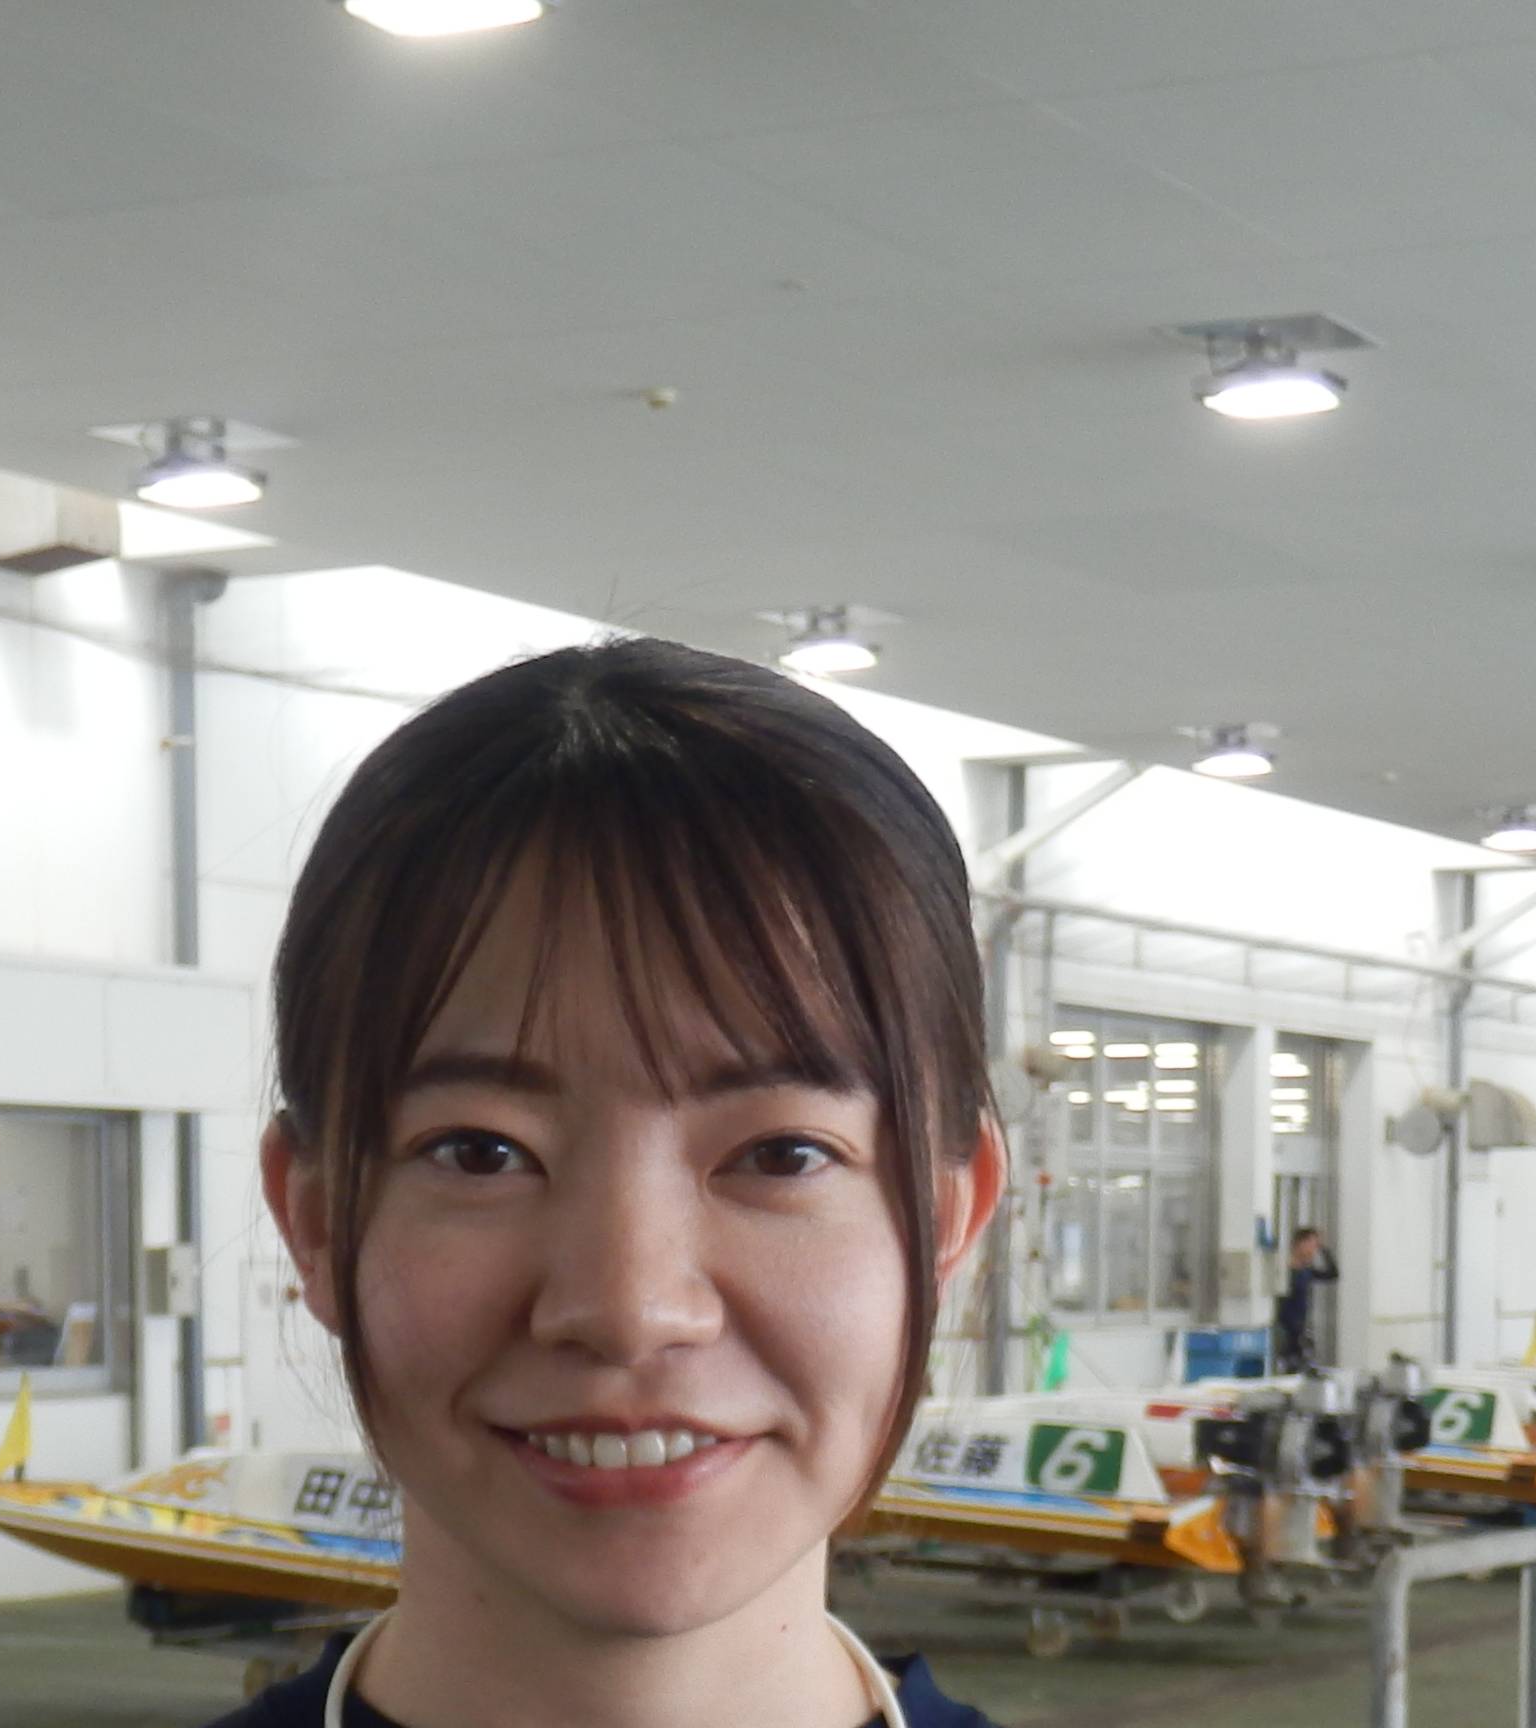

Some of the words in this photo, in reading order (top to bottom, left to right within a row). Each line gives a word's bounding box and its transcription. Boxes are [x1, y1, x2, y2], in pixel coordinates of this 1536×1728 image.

[1430, 1391, 1483, 1442] 6
[1038, 1428, 1109, 1491] 6
[294, 1466, 393, 1525] 田中
